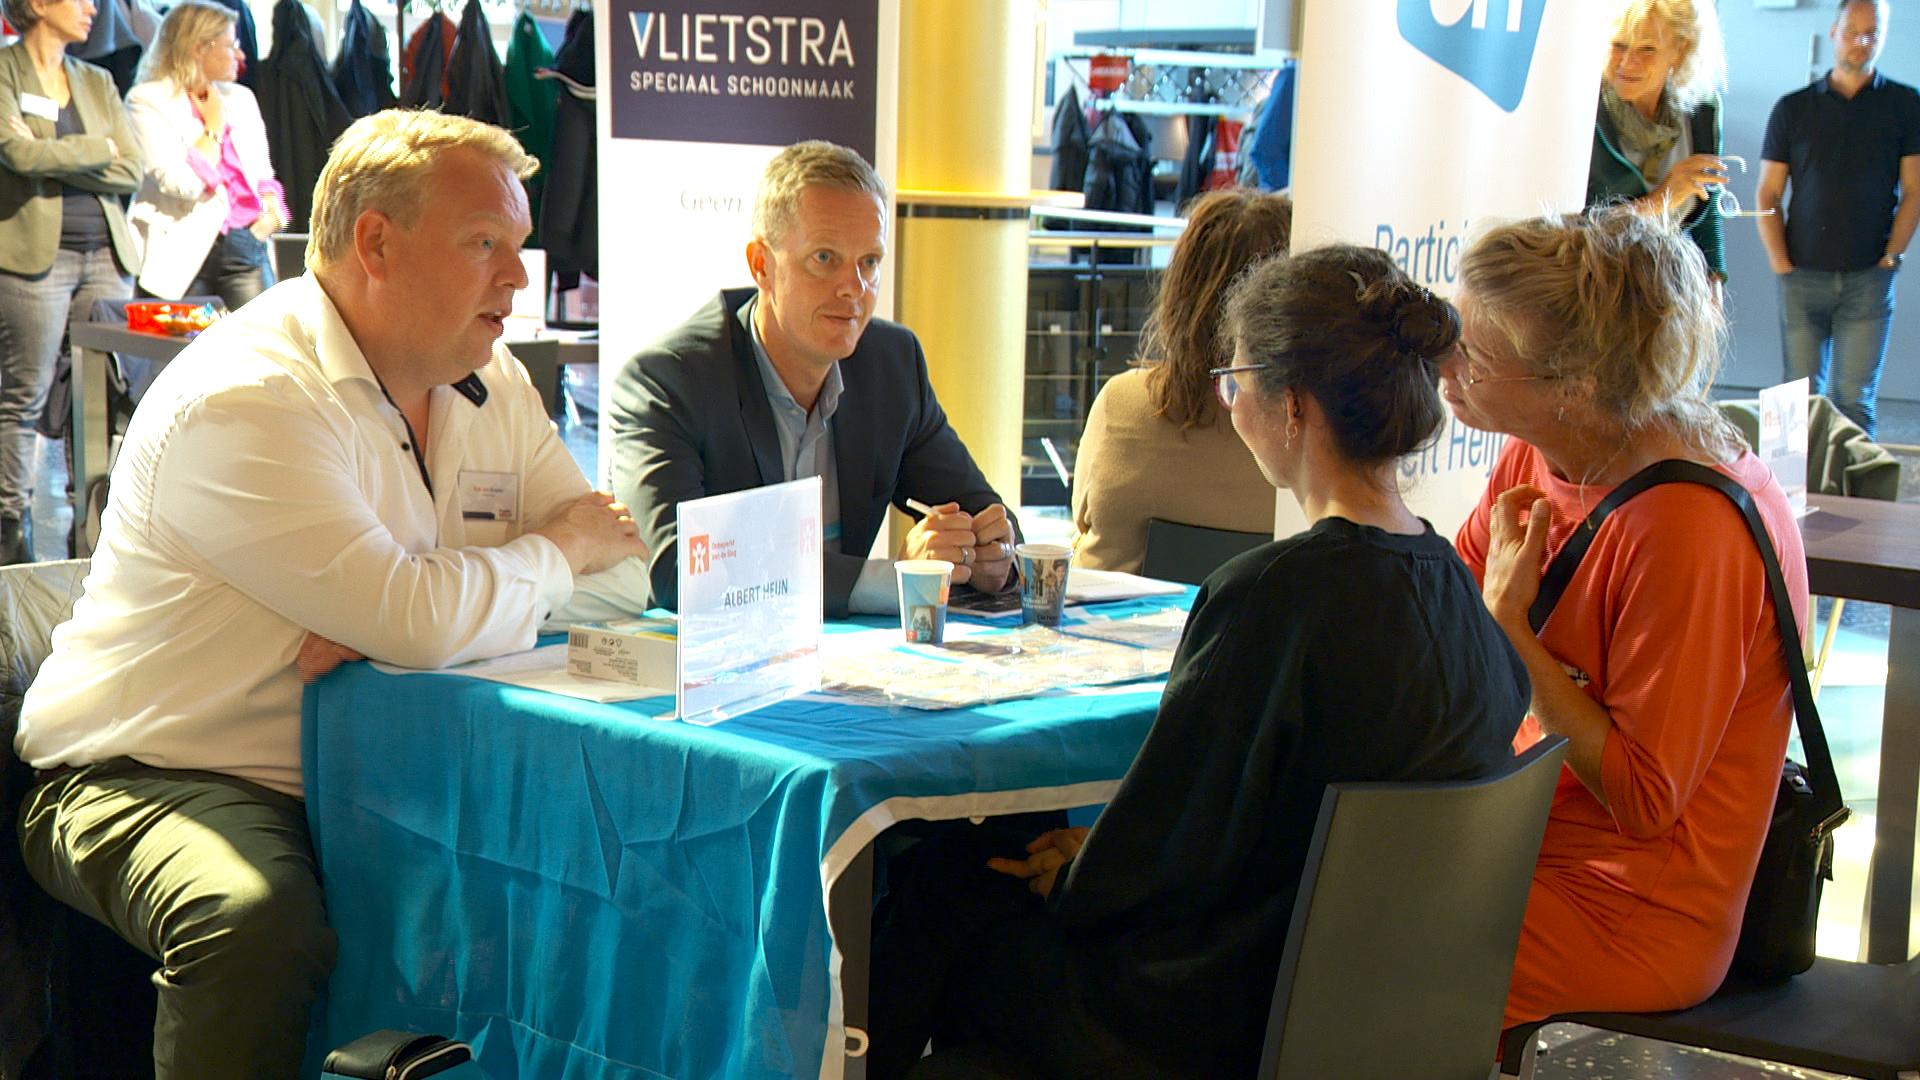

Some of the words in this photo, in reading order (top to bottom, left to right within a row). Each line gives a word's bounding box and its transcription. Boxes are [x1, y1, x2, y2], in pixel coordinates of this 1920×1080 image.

[628, 11, 855, 67] VLIETSTRA
[630, 70, 720, 95] SPECIAAL
[727, 75, 855, 99] SCHOONMAAK
[724, 585, 761, 609] ALBERT
[762, 578, 788, 601] HEIJN
